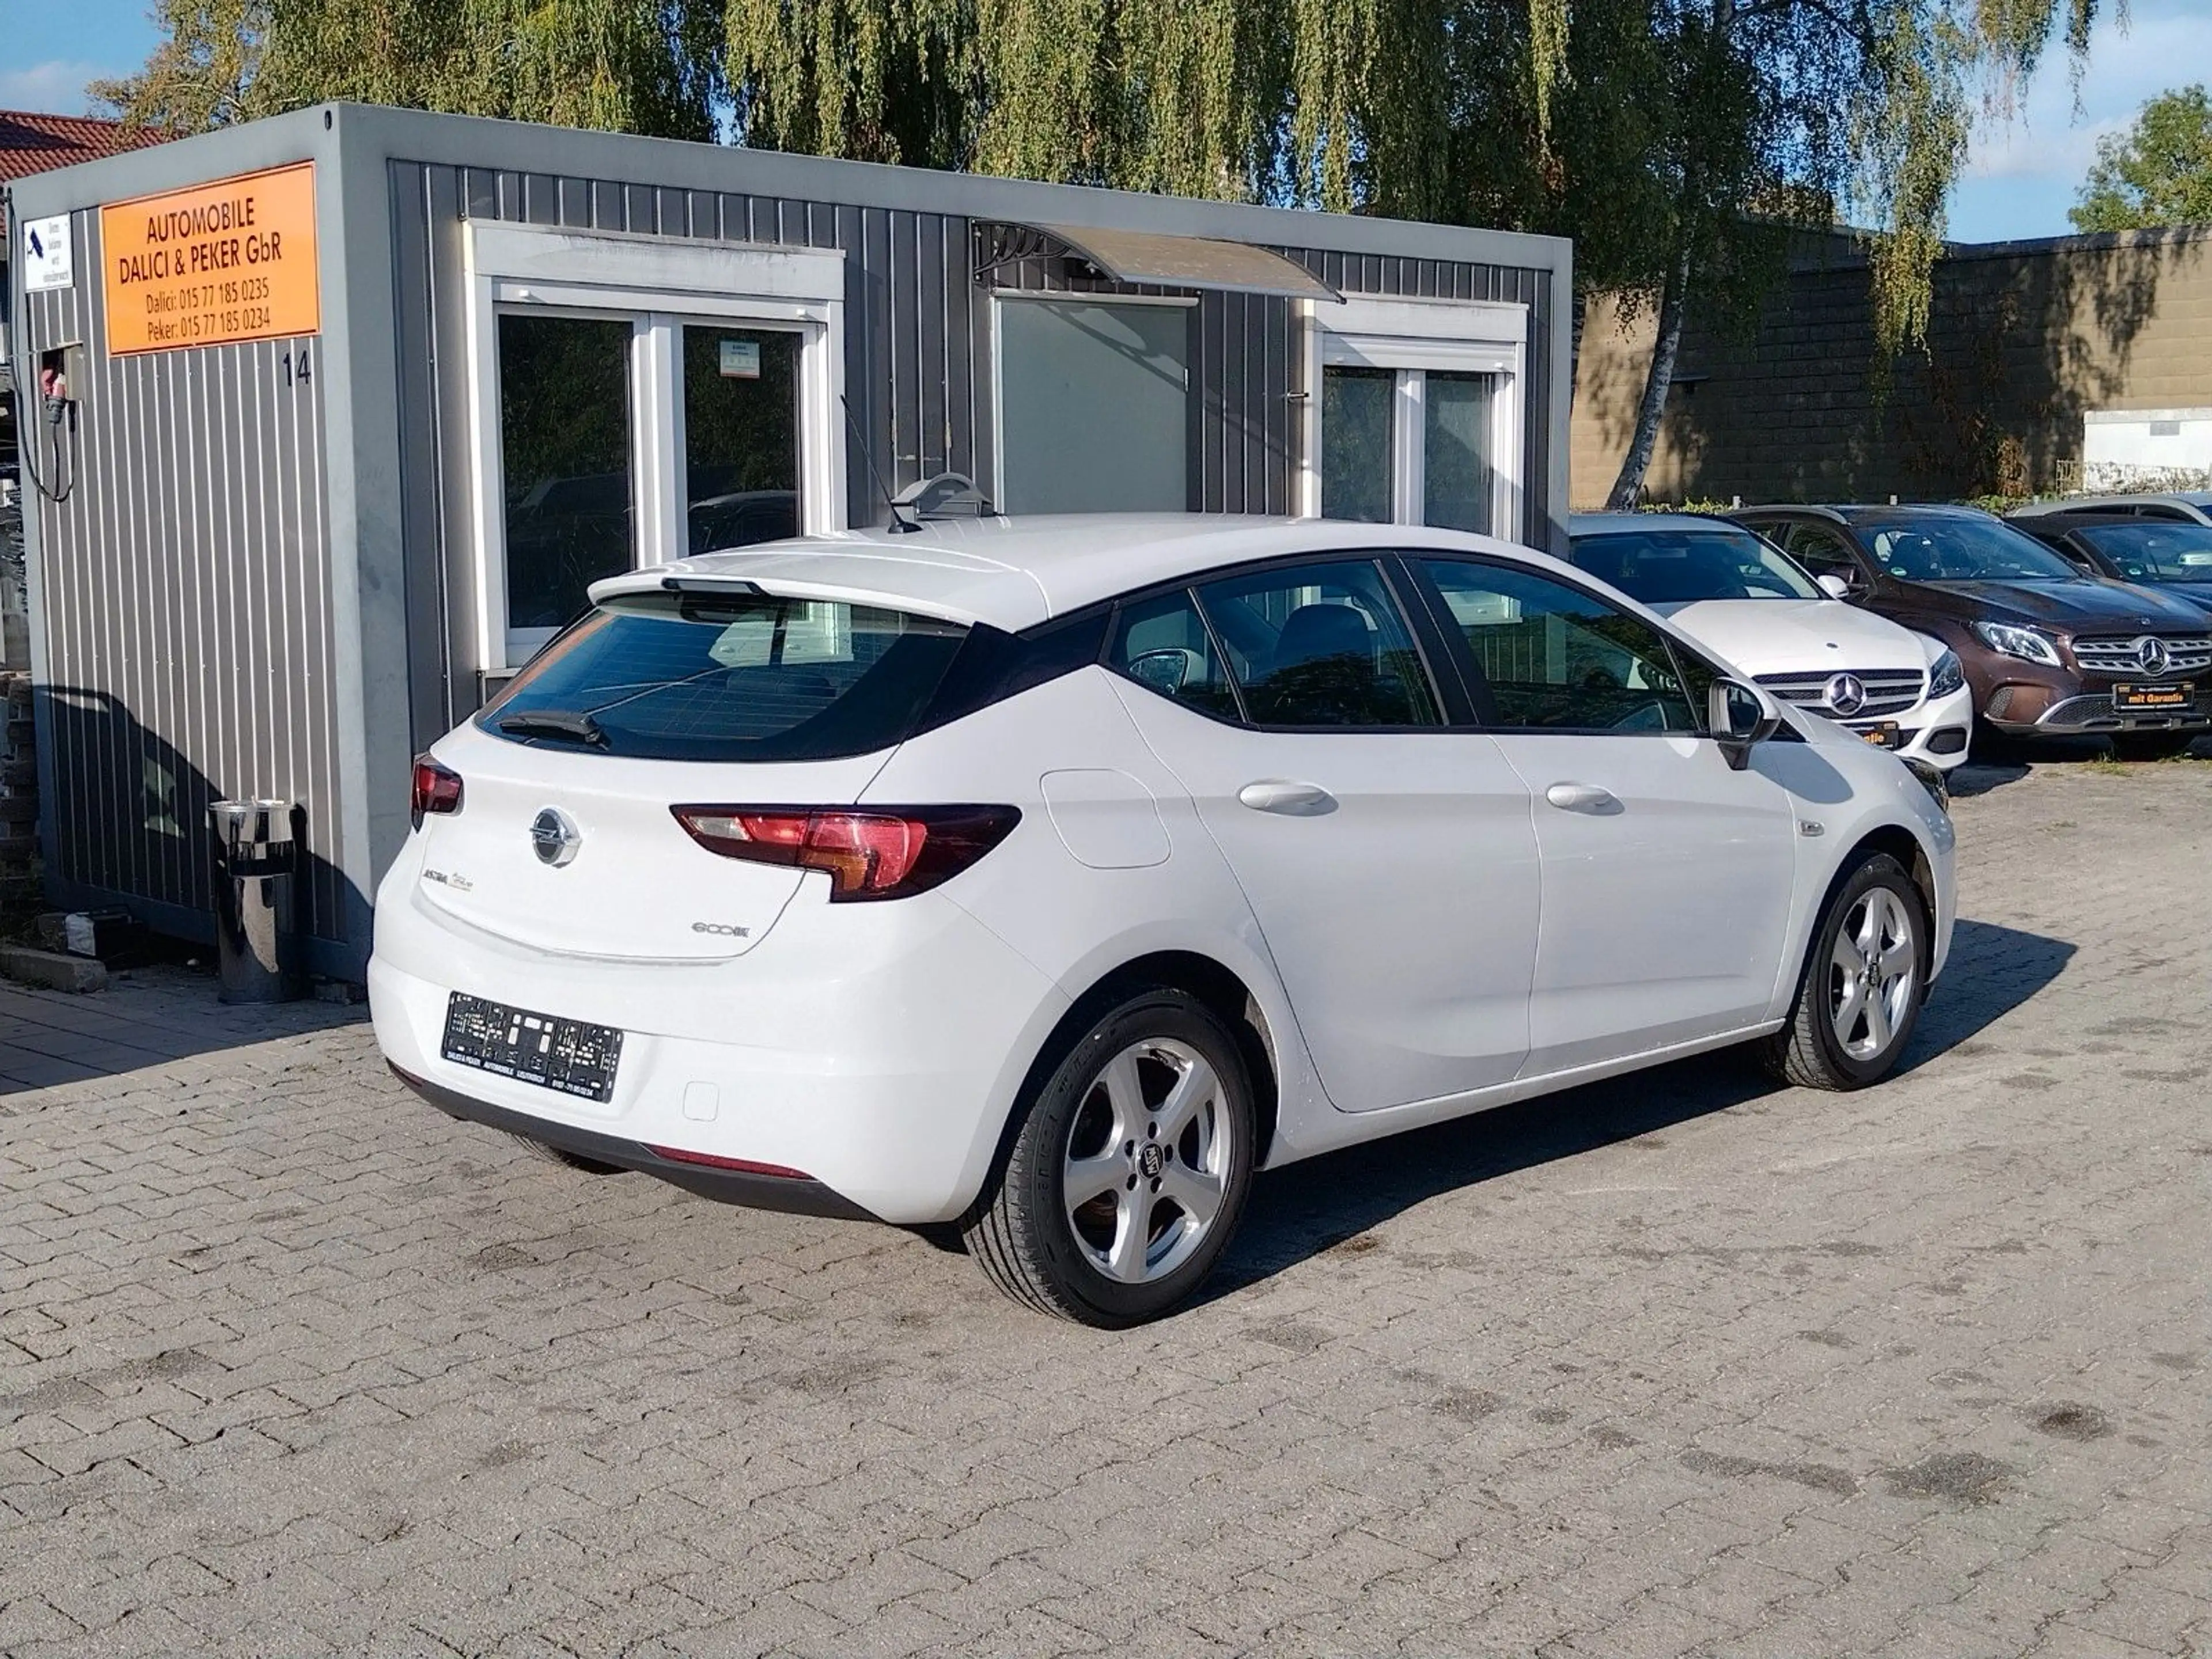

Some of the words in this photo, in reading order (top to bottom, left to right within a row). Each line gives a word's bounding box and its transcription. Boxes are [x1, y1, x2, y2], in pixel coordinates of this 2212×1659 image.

[146, 197, 255, 244] AUTOMOBILE
[119, 249, 169, 285] DALICI
[175, 248, 186, 276] &
[191, 238, 241, 273] PEKER
[245, 231, 282, 264] GbR
[146, 290, 177, 314] Dalici:
[179, 287, 199, 310] 015
[202, 285, 214, 307] 77
[219, 281, 238, 305] 185
[241, 276, 270, 301] 0235
[147, 317, 179, 342] Peker:
[181, 315, 200, 338] 015
[203, 313, 216, 336] 77
[219, 310, 240, 333] 185
[243, 306, 271, 331] 0234
[283, 350, 311, 387] 14
[2128, 693, 2145, 703] mit
[2146, 692, 2184, 703] Garantie
